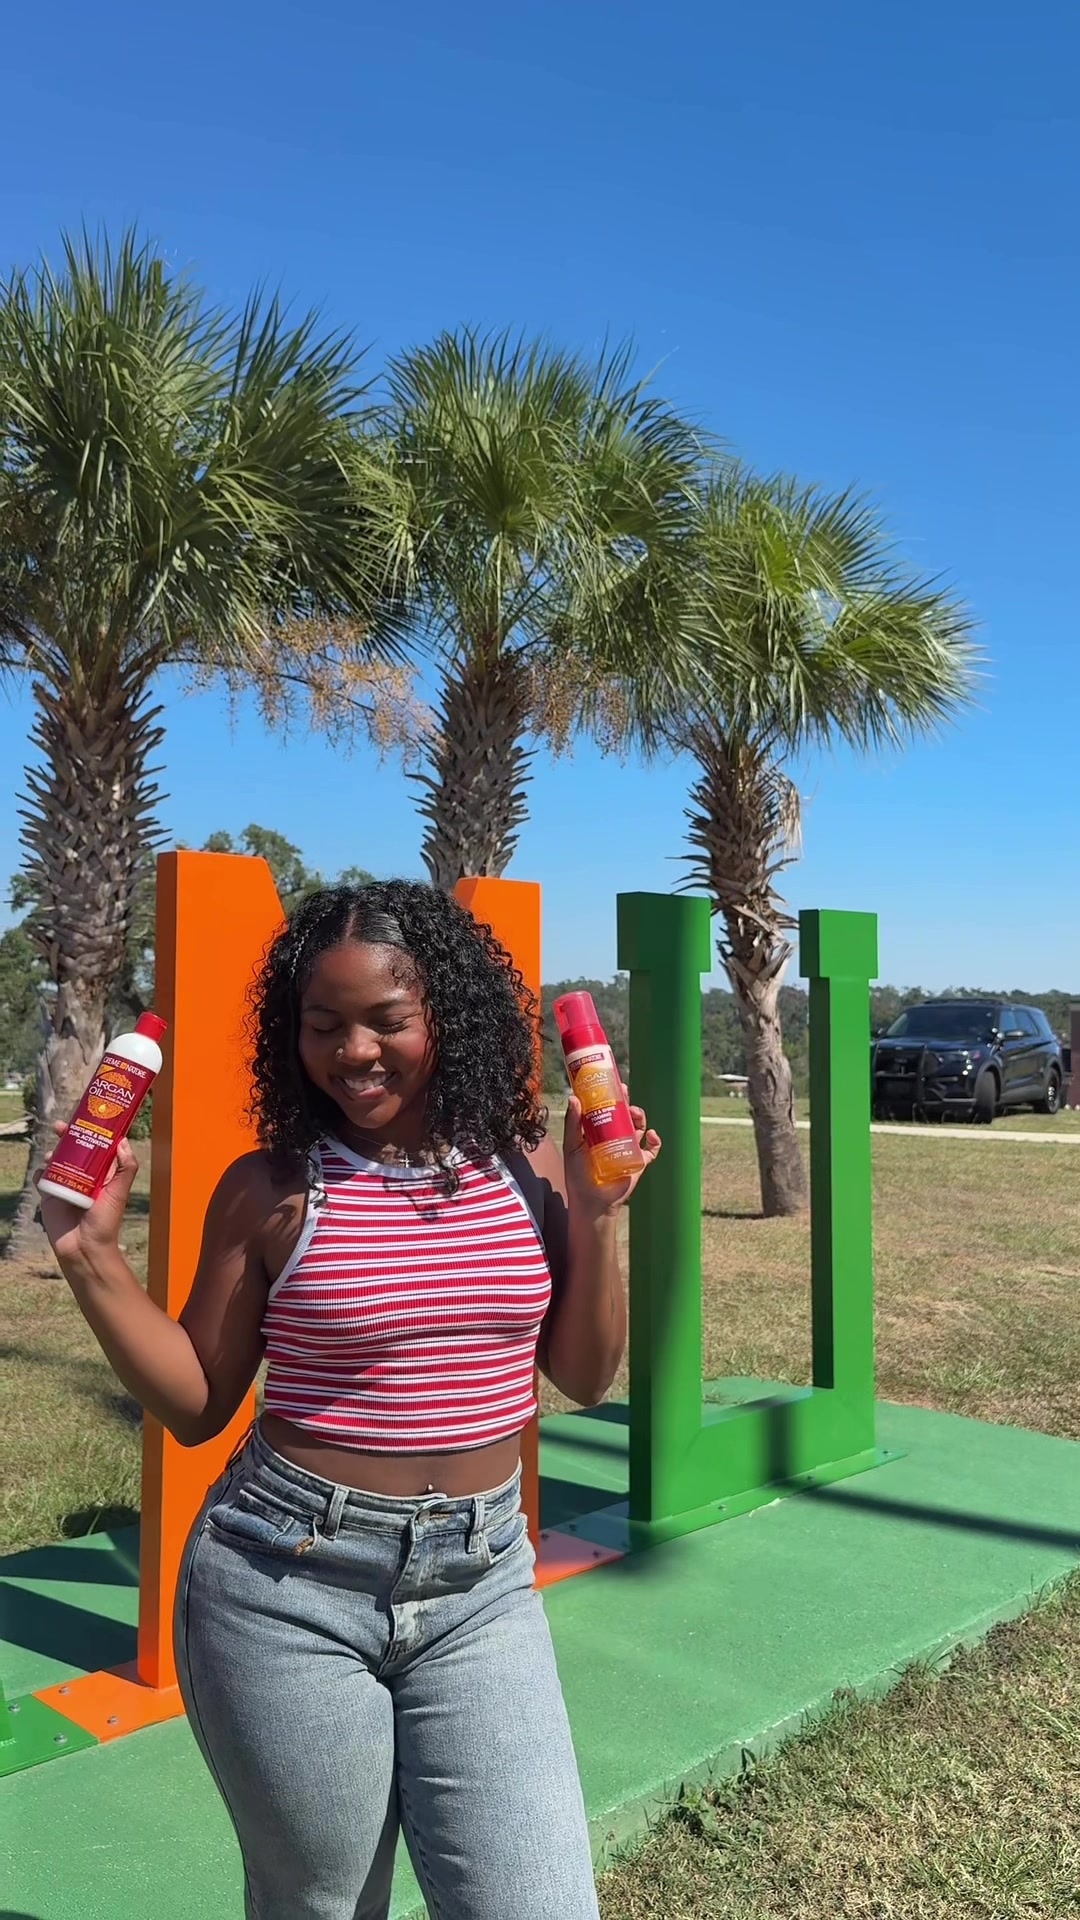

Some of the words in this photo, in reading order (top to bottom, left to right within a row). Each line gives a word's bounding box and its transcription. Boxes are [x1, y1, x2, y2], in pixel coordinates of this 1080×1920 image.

[103, 1056, 121, 1067] CREME
[89, 1085, 107, 1098] OIL
[92, 1078, 136, 1101] ARGAN
[69, 1130, 82, 1138] CURL
[81, 1133, 109, 1149] ACTIVATOR
[70, 1124, 94, 1136] MOISTURE
[98, 1134, 114, 1144] SHINE
[75, 1139, 95, 1150] CREME
